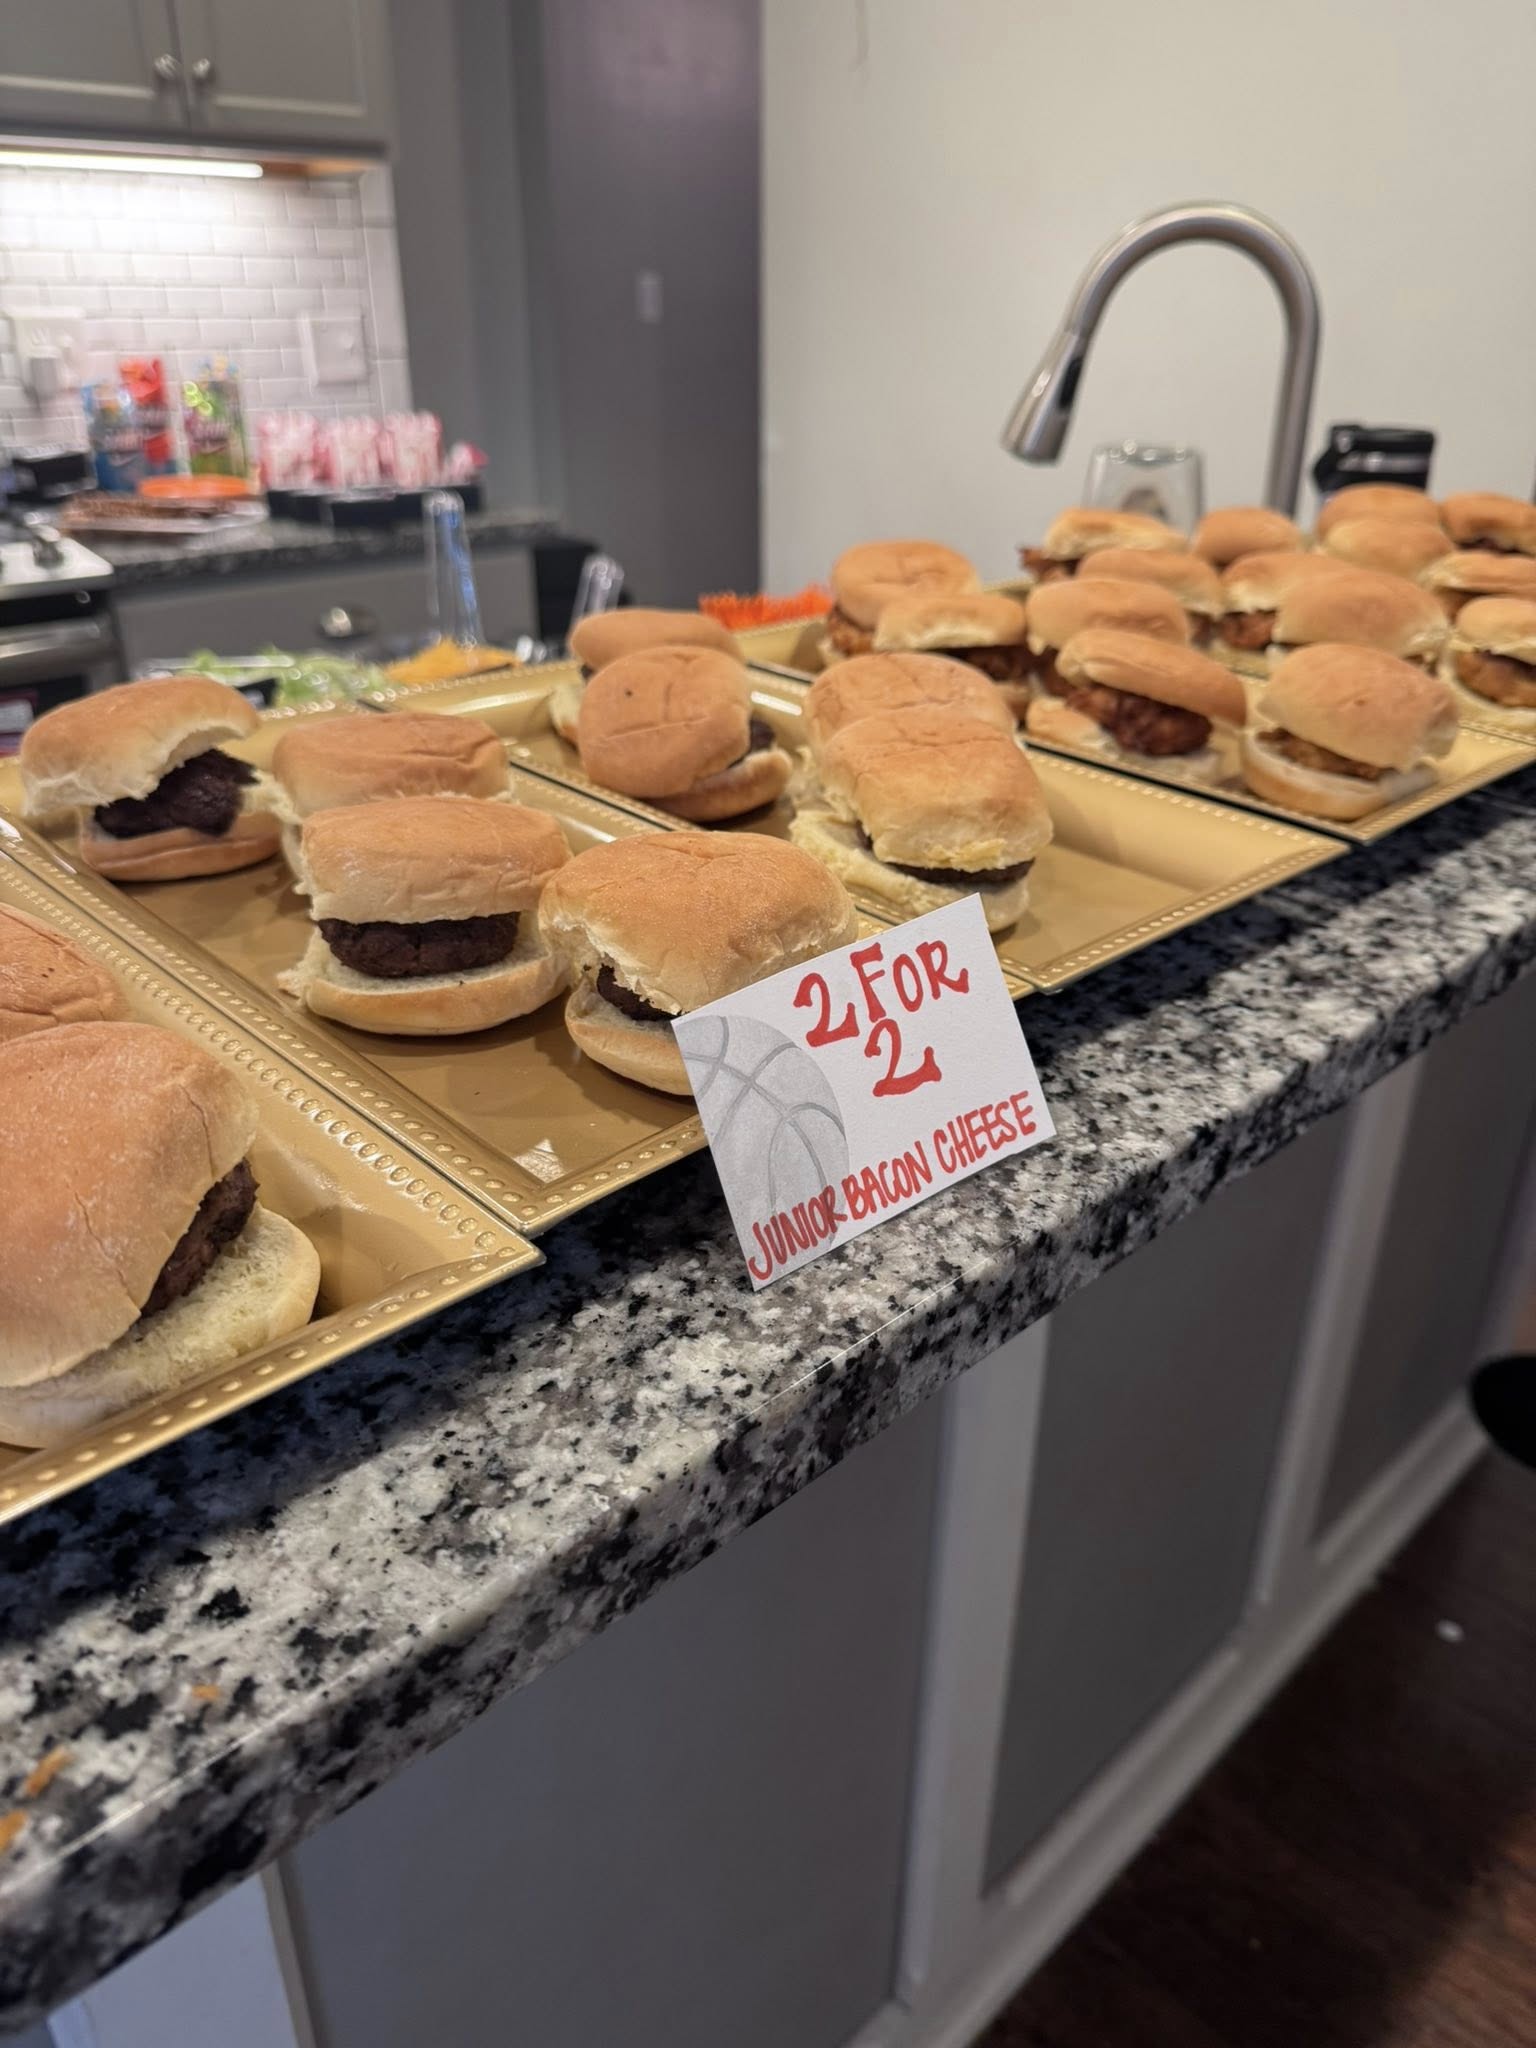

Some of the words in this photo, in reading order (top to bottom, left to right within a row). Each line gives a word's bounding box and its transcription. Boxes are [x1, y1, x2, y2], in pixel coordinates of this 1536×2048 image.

[793, 972, 860, 1048] 2
[850, 940, 970, 1023] FOR
[863, 1018, 942, 1097] 2
[749, 1185, 848, 1280] JUNIOR
[842, 1141, 933, 1220] BACON
[933, 1090, 1037, 1174] CHEESE
